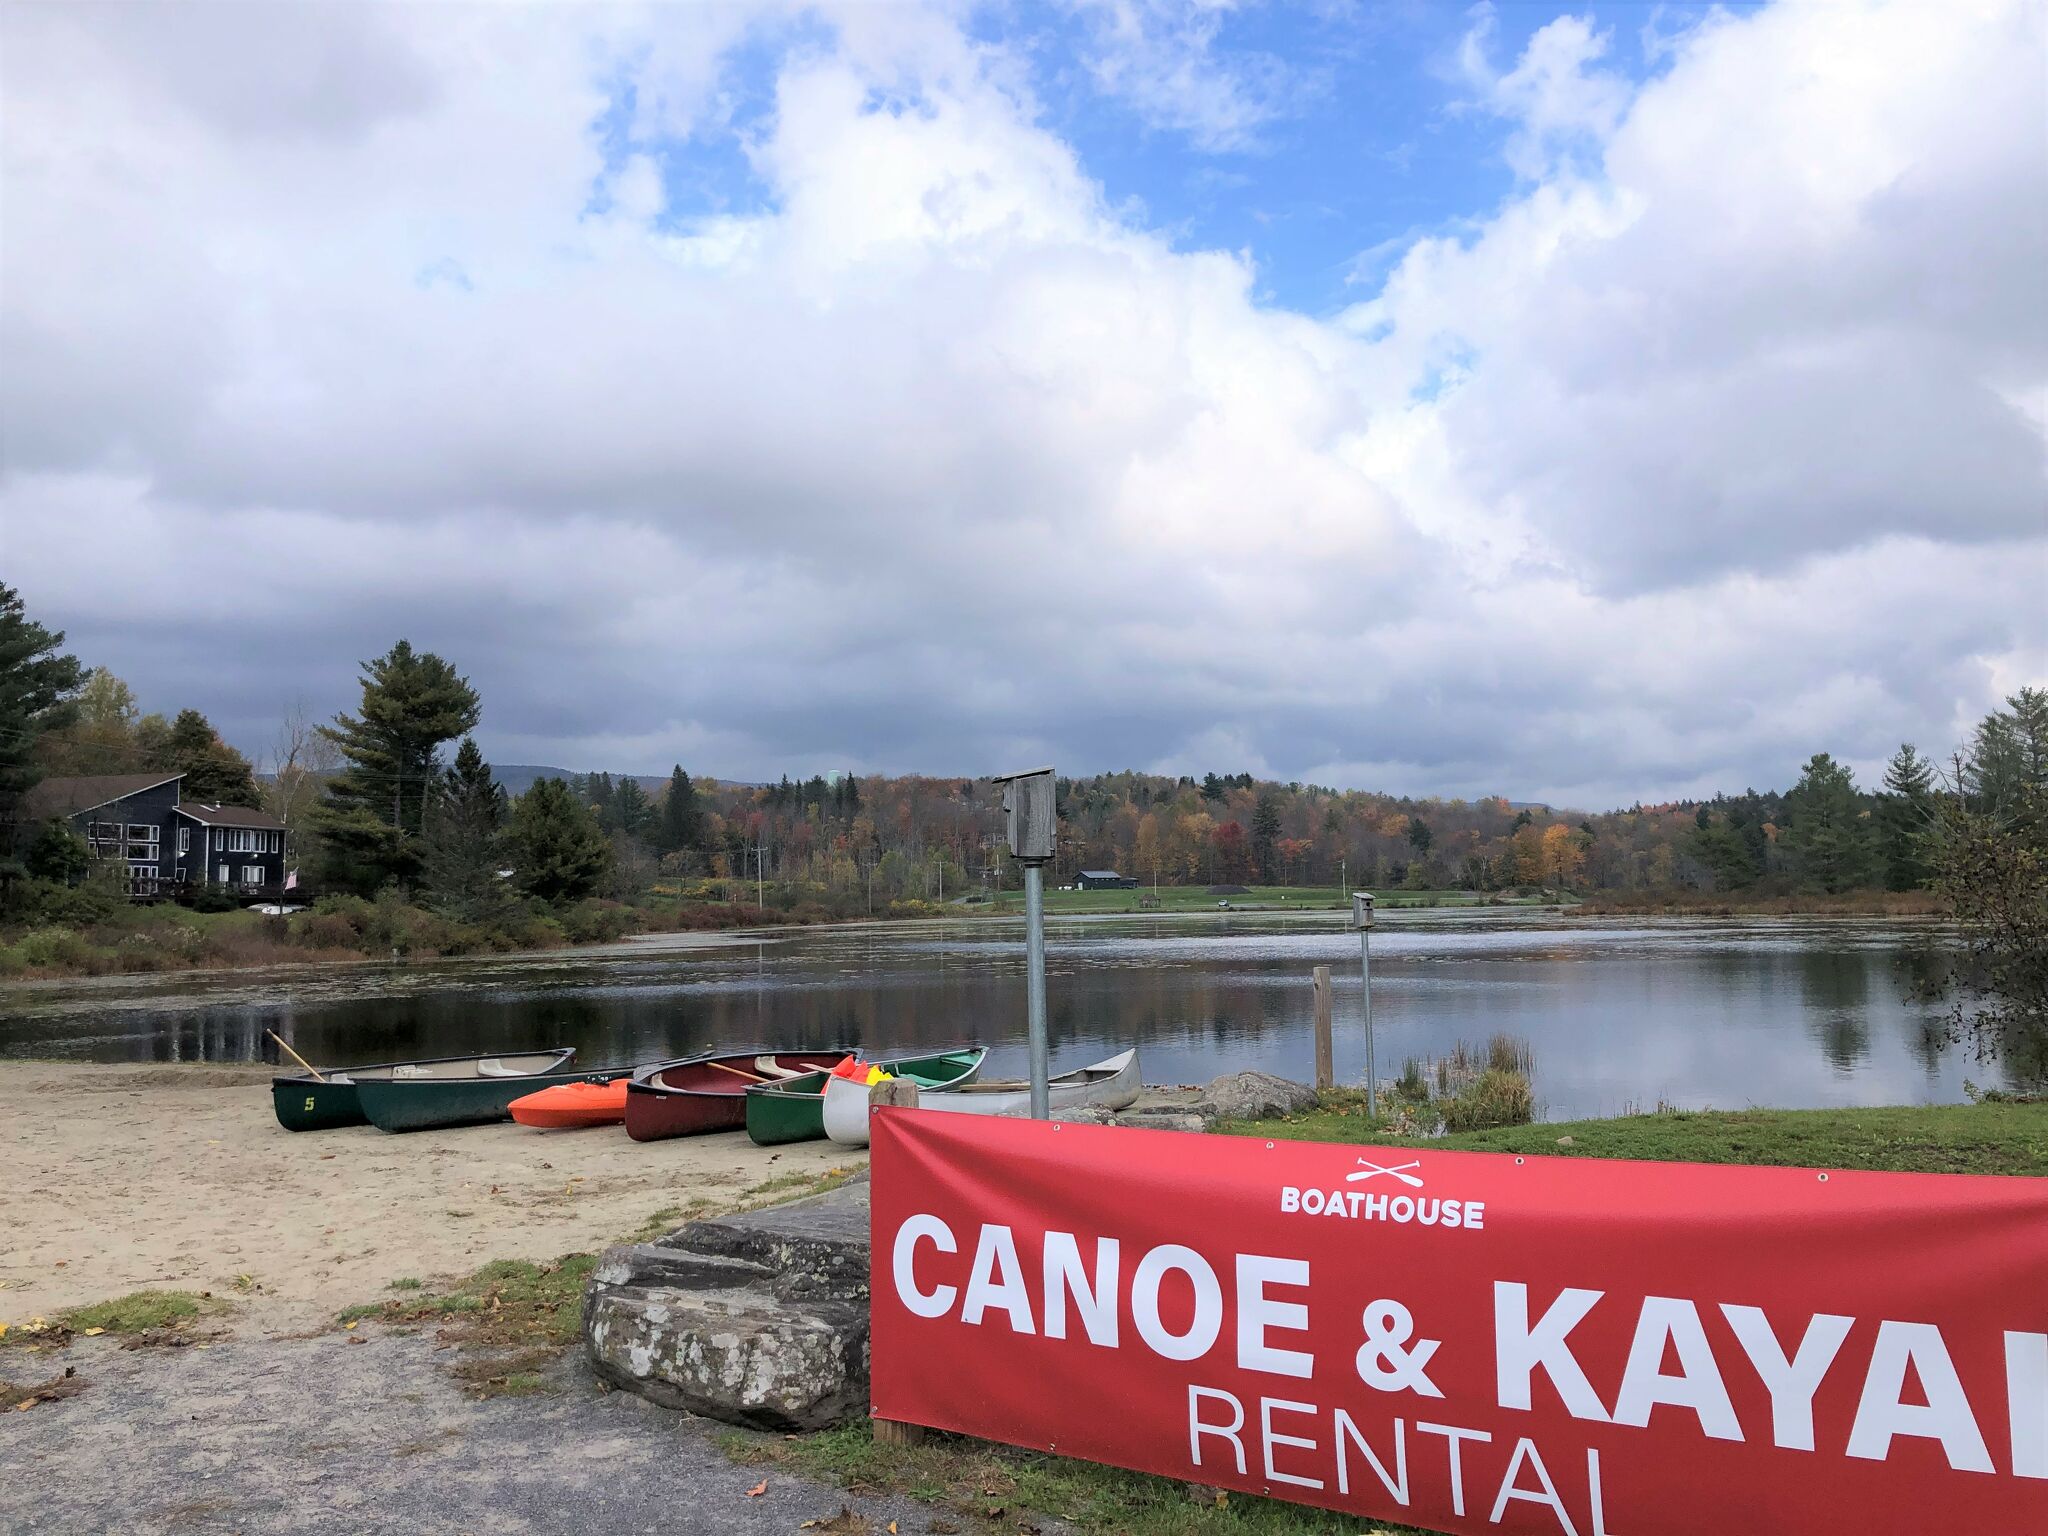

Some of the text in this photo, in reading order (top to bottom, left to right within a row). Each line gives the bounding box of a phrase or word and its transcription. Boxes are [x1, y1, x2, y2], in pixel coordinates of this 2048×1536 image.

[304, 1096, 315, 1111] 5
[1280, 1186, 1486, 1230] BOATHOUSE
[892, 1213, 1316, 1379] CANOE
[1355, 1298, 1446, 1399] &
